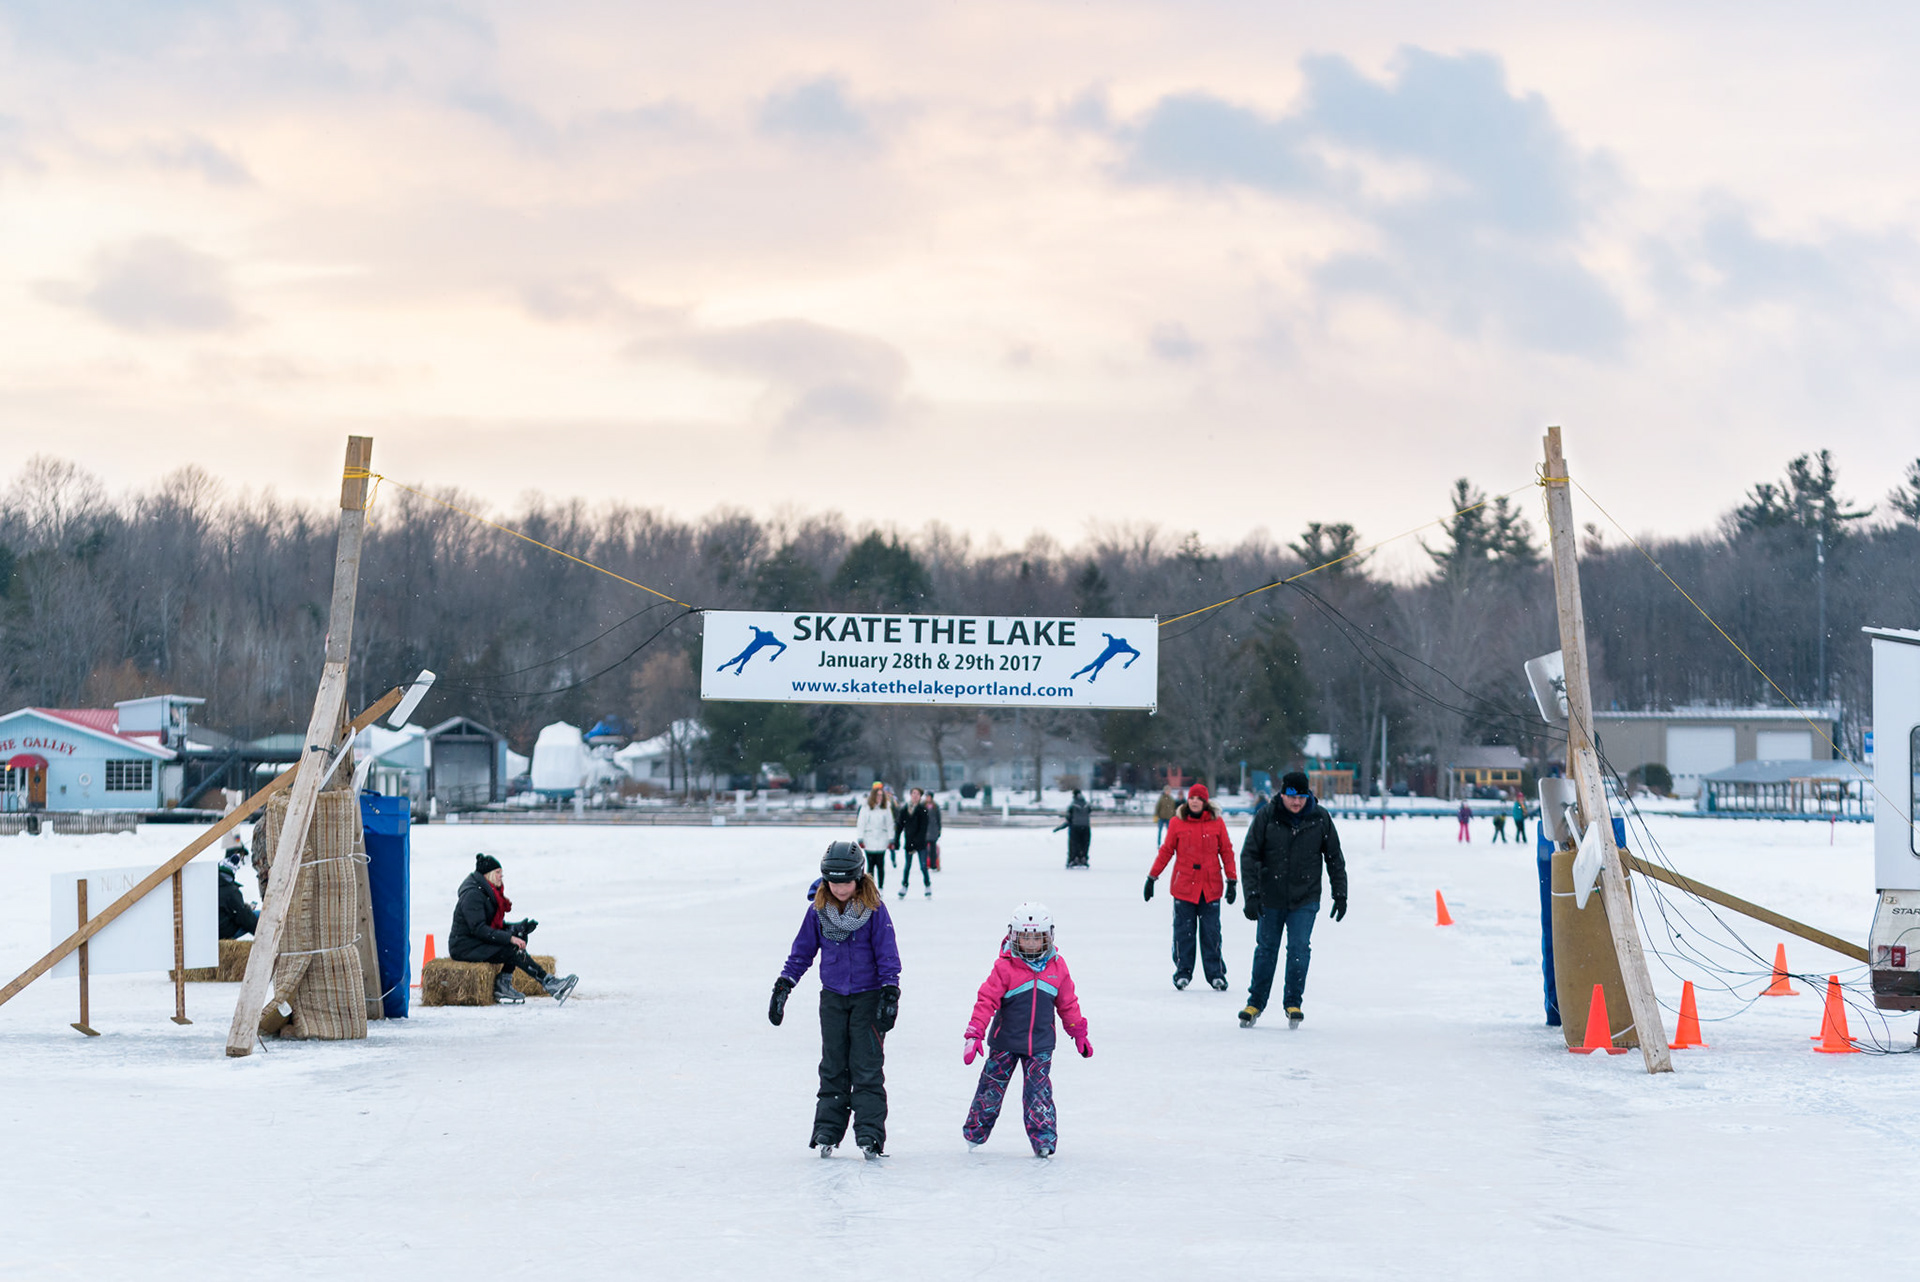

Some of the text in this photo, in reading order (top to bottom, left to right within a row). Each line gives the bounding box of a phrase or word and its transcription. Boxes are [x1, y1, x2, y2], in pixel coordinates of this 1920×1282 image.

[793, 615, 1076, 647] SKATE THE LAKE
[818, 651, 1042, 673] January 28th & 29th 2017
[792, 679, 1074, 698] www.skatethelakeportland.com
[23, 736, 77, 756] GALLEY
